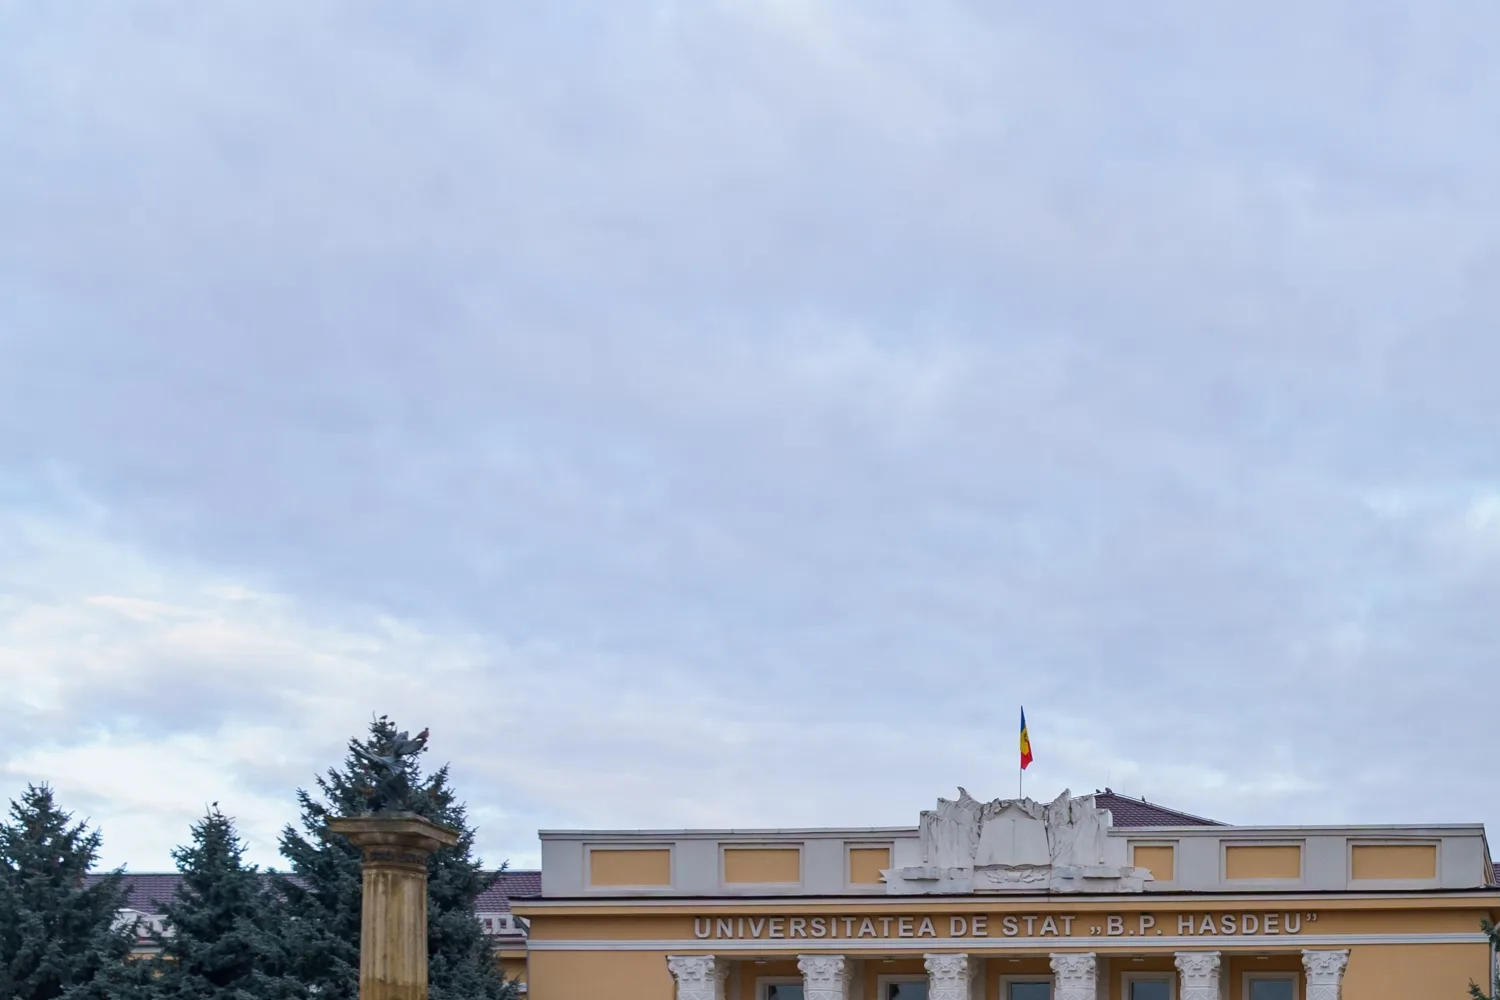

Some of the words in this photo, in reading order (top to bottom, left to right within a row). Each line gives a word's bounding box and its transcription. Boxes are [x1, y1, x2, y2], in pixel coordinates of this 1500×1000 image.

[694, 916, 937, 938] UNIVERSITATEA
[950, 916, 987, 937] DE
[1002, 915, 1075, 936] STAT
